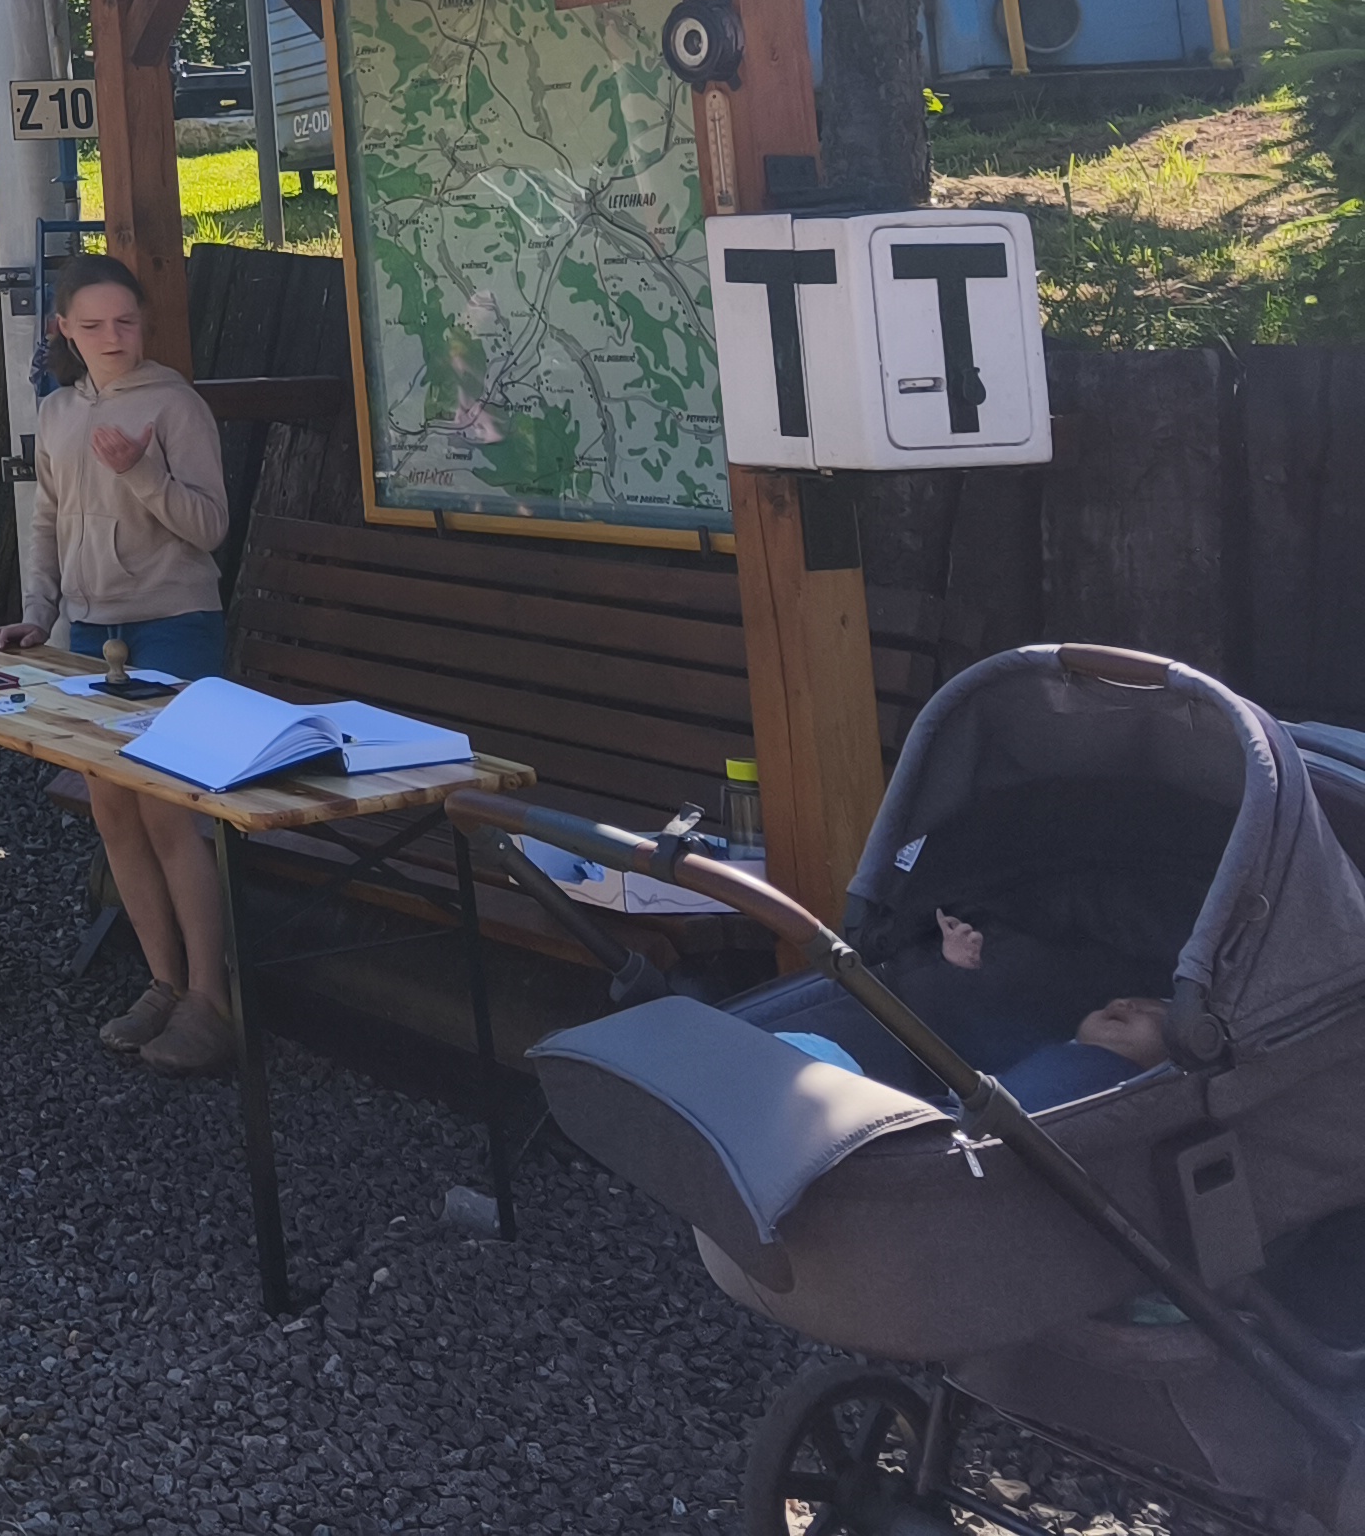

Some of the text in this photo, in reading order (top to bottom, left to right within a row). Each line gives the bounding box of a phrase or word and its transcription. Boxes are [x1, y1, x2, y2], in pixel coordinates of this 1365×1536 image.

[17, 88, 93, 130] Z 10
[293, 110, 332, 137] CZ-OD
[608, 192, 657, 209] LETOHRAD
[724, 248, 837, 437] T
[891, 242, 1008, 433] T
